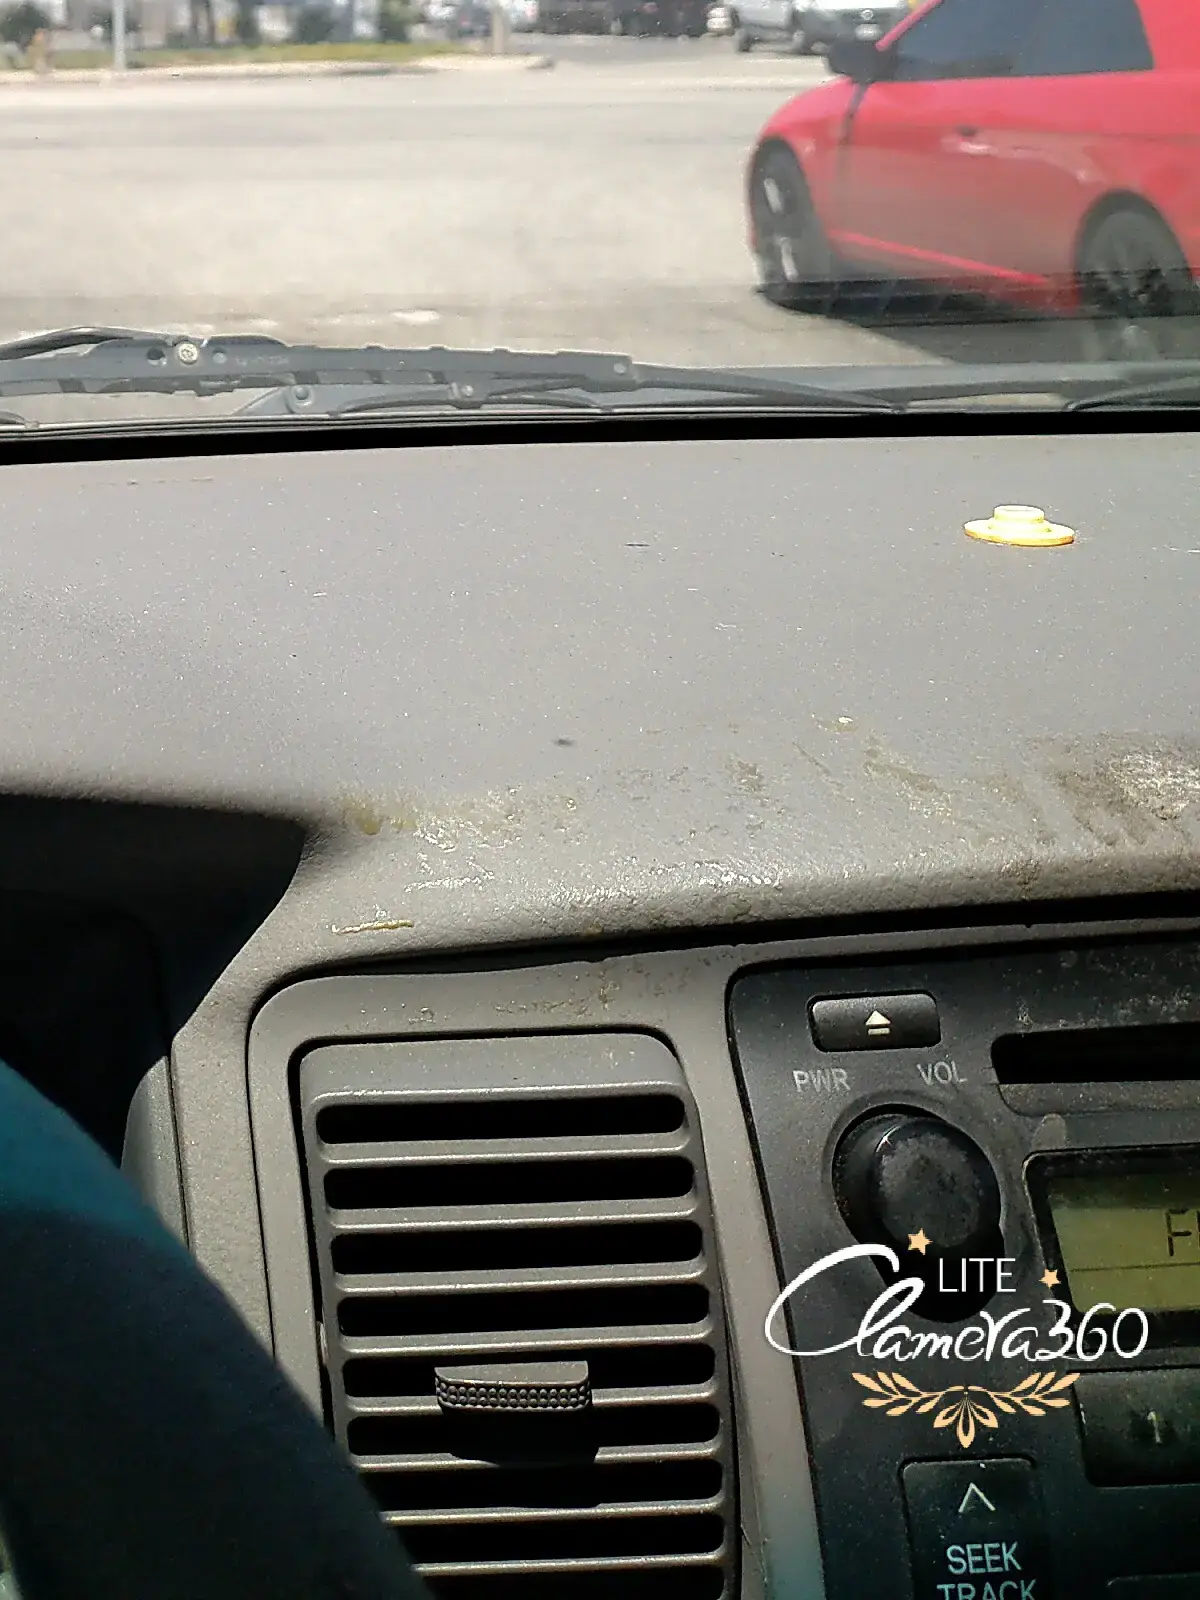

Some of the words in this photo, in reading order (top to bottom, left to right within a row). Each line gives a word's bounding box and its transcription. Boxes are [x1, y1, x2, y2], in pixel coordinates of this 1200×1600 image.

[793, 1067, 851, 1093] PWR
[916, 1060, 968, 1086] VOL
[946, 1541, 1022, 1574] SEEK
[936, 1578, 1036, 1600] TRACK
